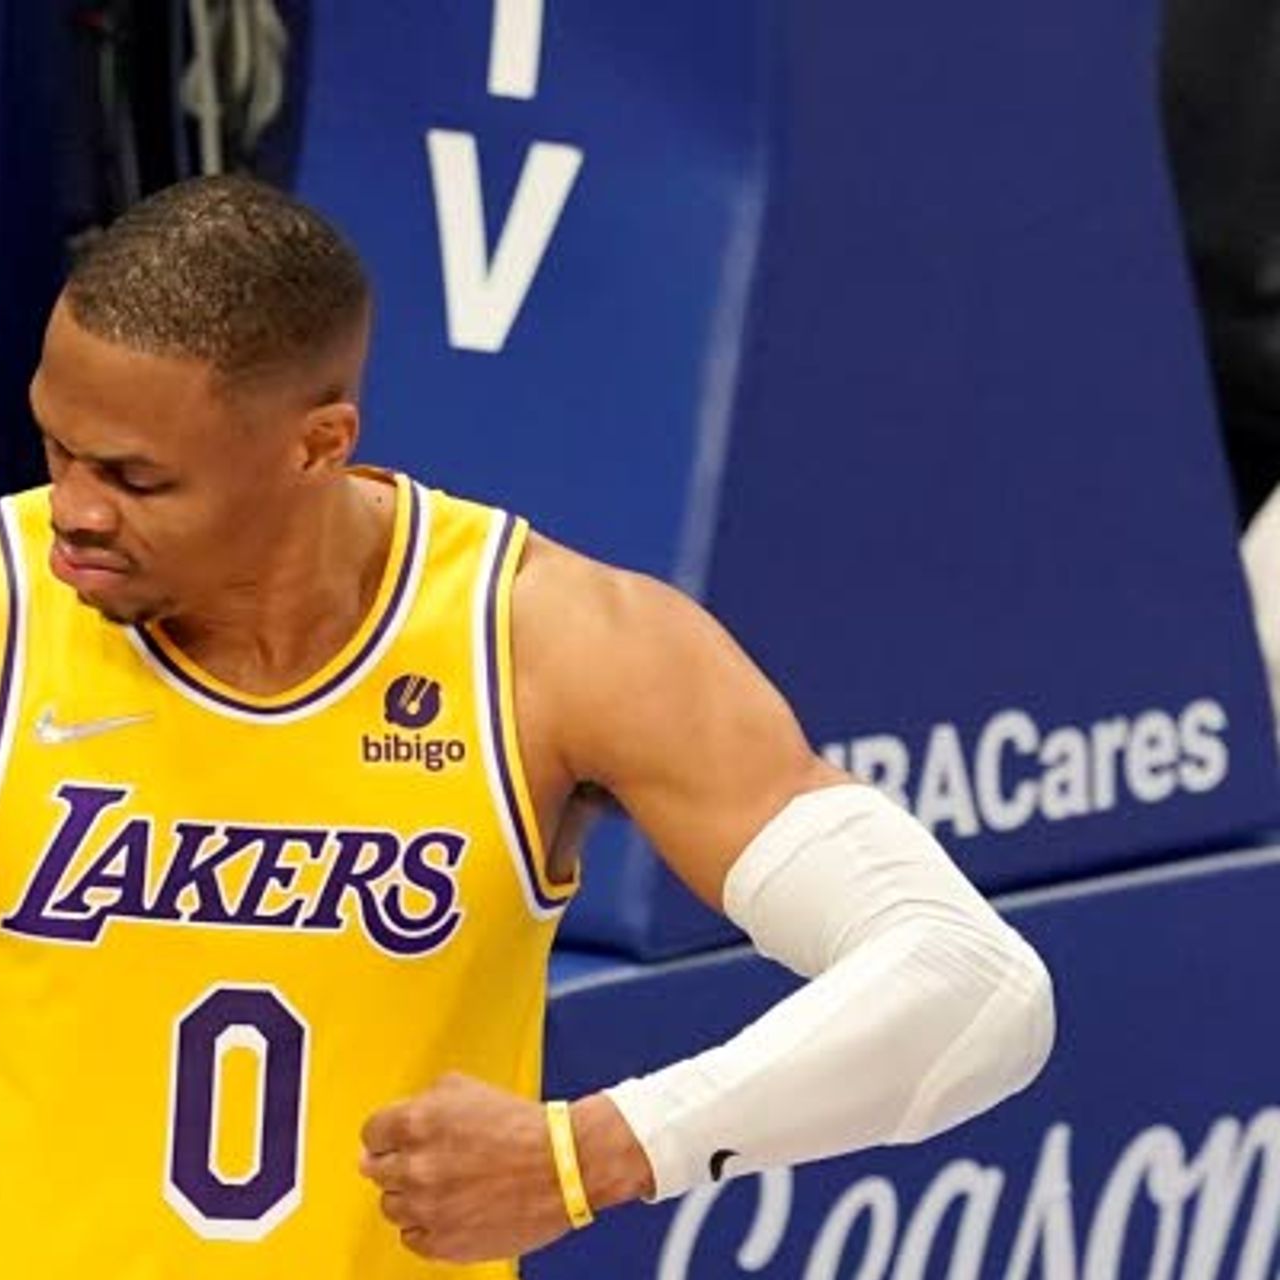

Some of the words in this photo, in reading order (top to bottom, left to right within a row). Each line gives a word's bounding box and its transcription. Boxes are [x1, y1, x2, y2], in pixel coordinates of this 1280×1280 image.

[361, 734, 466, 771] bibigo
[820, 697, 1231, 839] BACares
[161, 980, 311, 1241] 0
